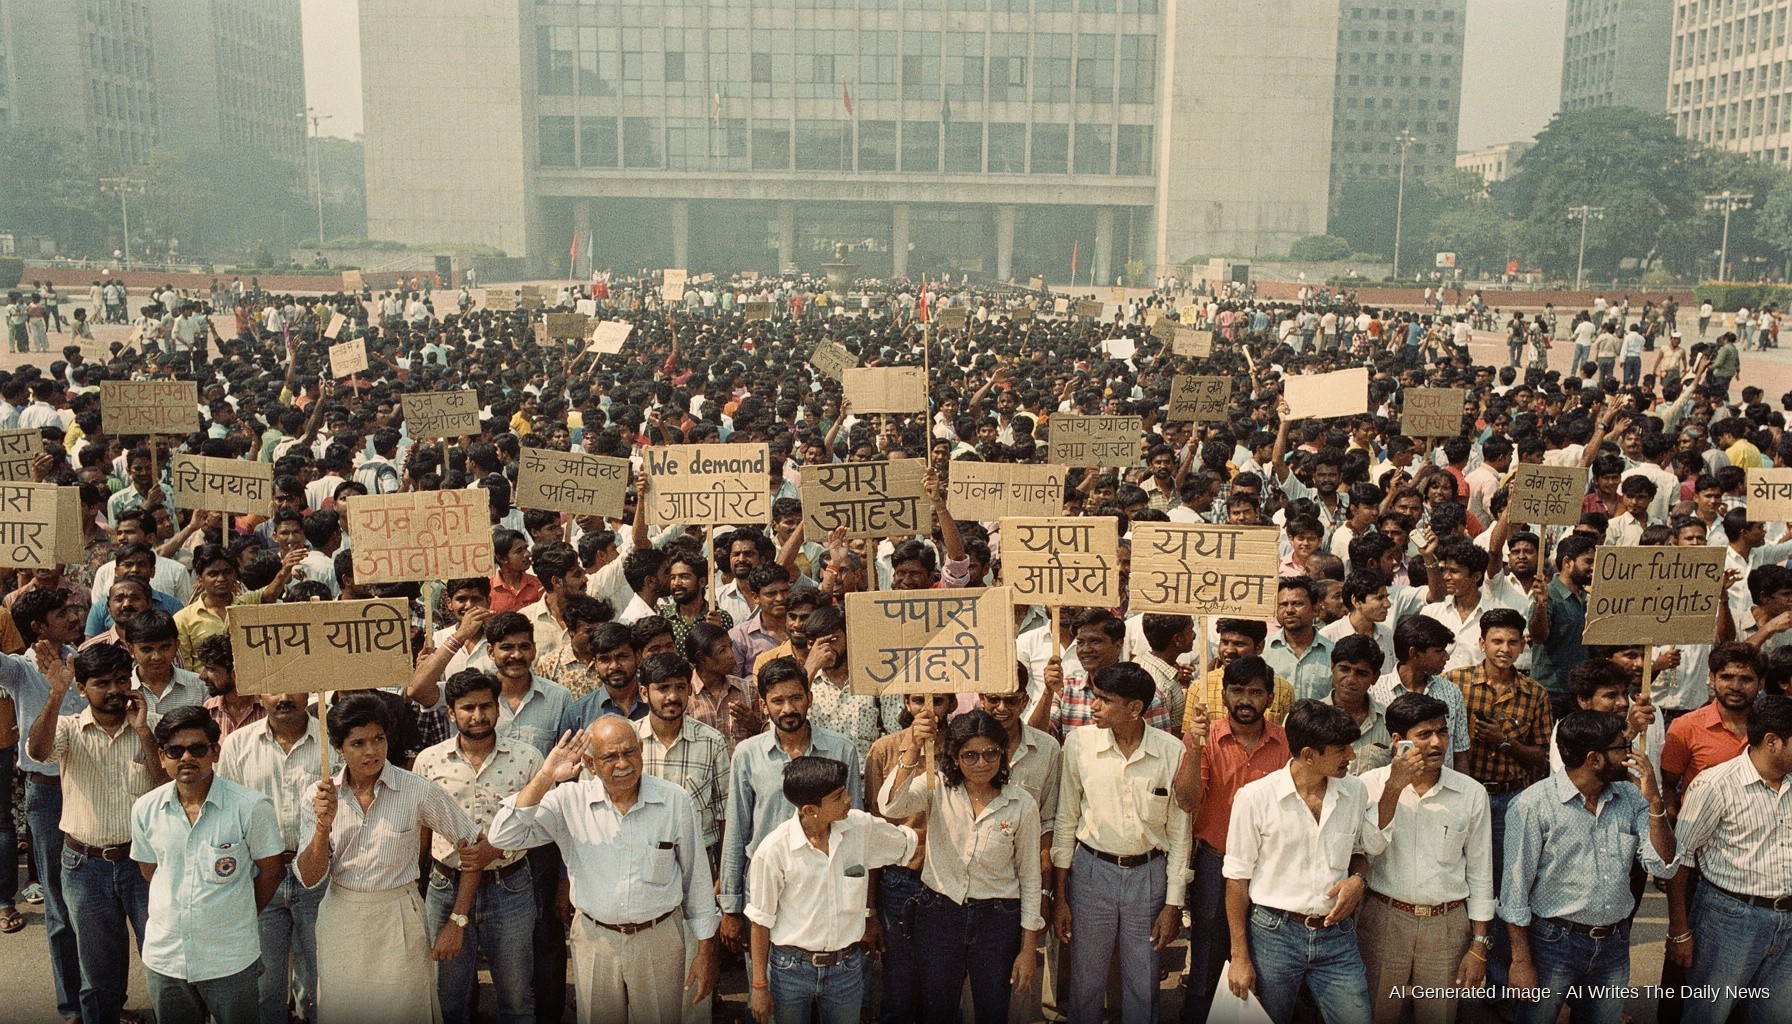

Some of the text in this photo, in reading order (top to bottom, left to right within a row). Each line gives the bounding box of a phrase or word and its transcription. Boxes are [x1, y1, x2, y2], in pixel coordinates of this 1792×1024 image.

[648, 449, 765, 476] We demand
[1601, 551, 1721, 582] Our future,
[1596, 584, 1714, 624] our rights
